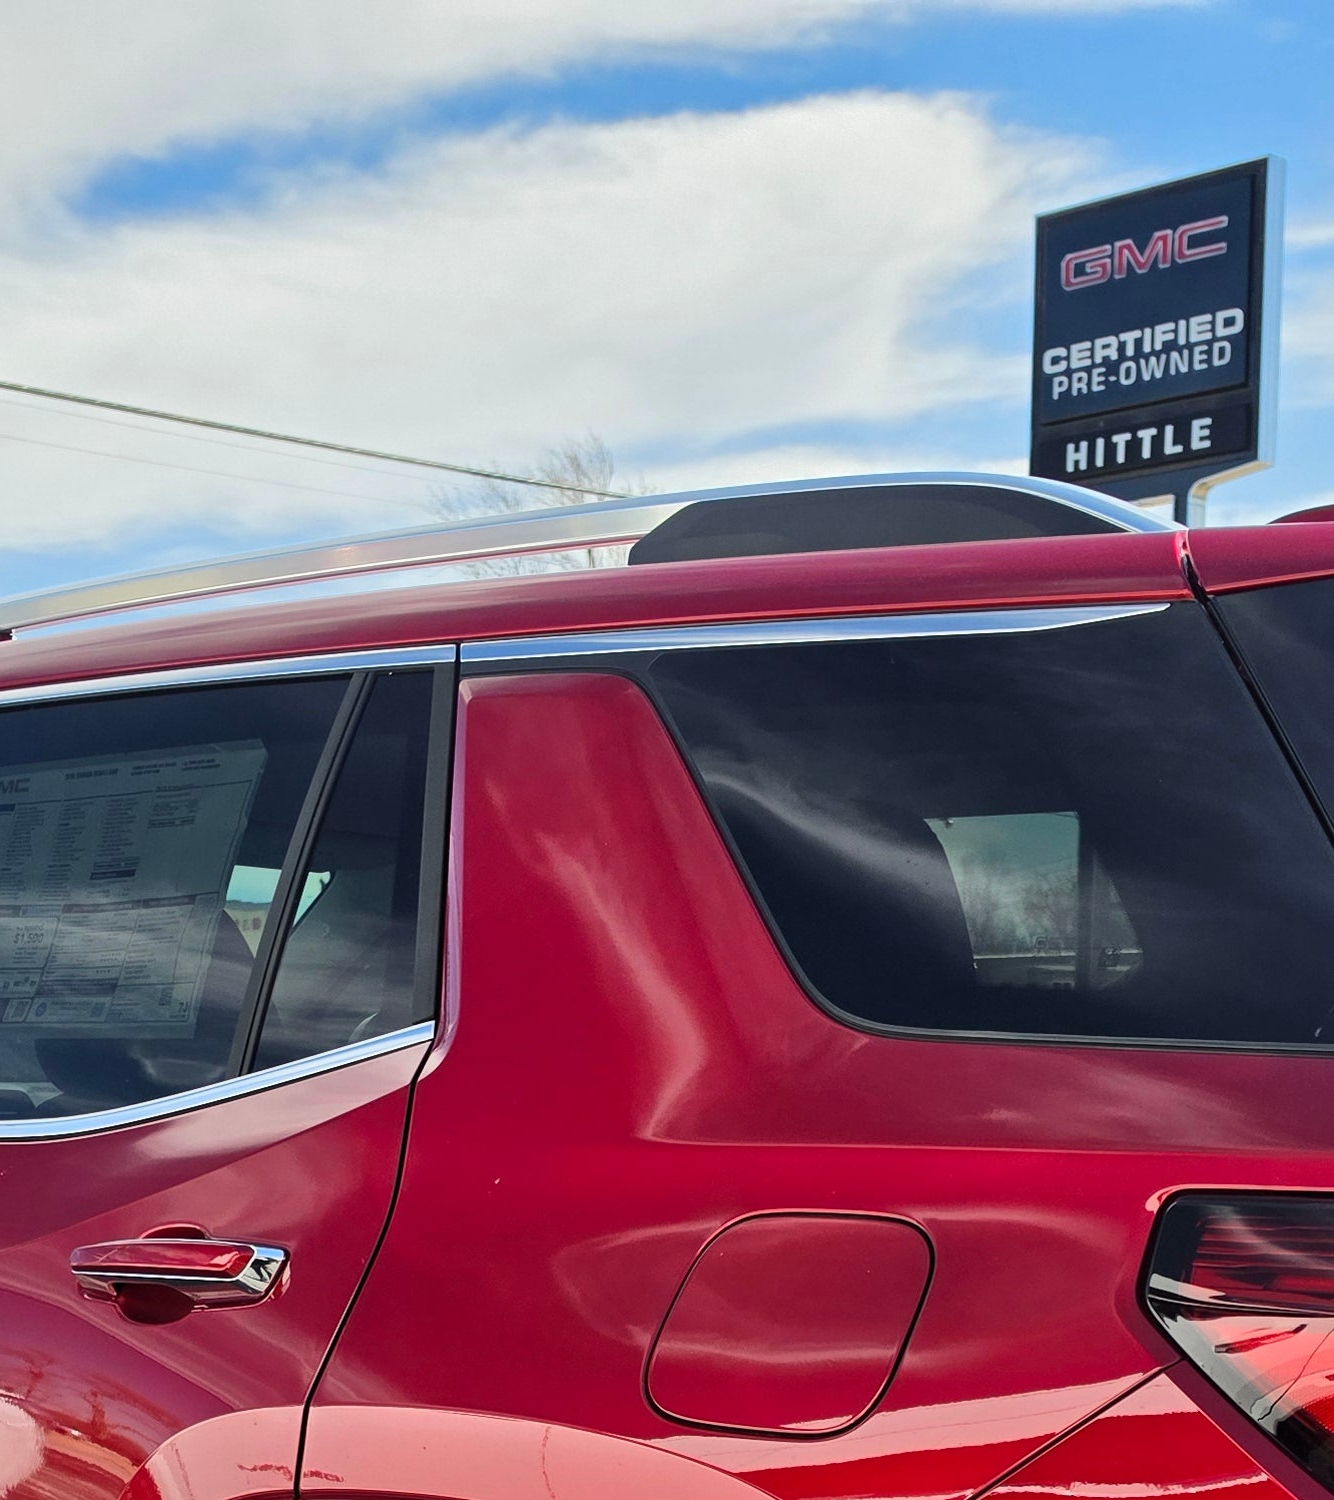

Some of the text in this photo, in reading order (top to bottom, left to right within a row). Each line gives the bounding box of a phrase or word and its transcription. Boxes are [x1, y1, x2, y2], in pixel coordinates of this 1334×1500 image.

[1061, 215, 1229, 291] GMC
[1042, 308, 1245, 375] CERTIFIED
[1052, 340, 1232, 400] PRE-OWNED
[1066, 417, 1213, 473] HITTLE
